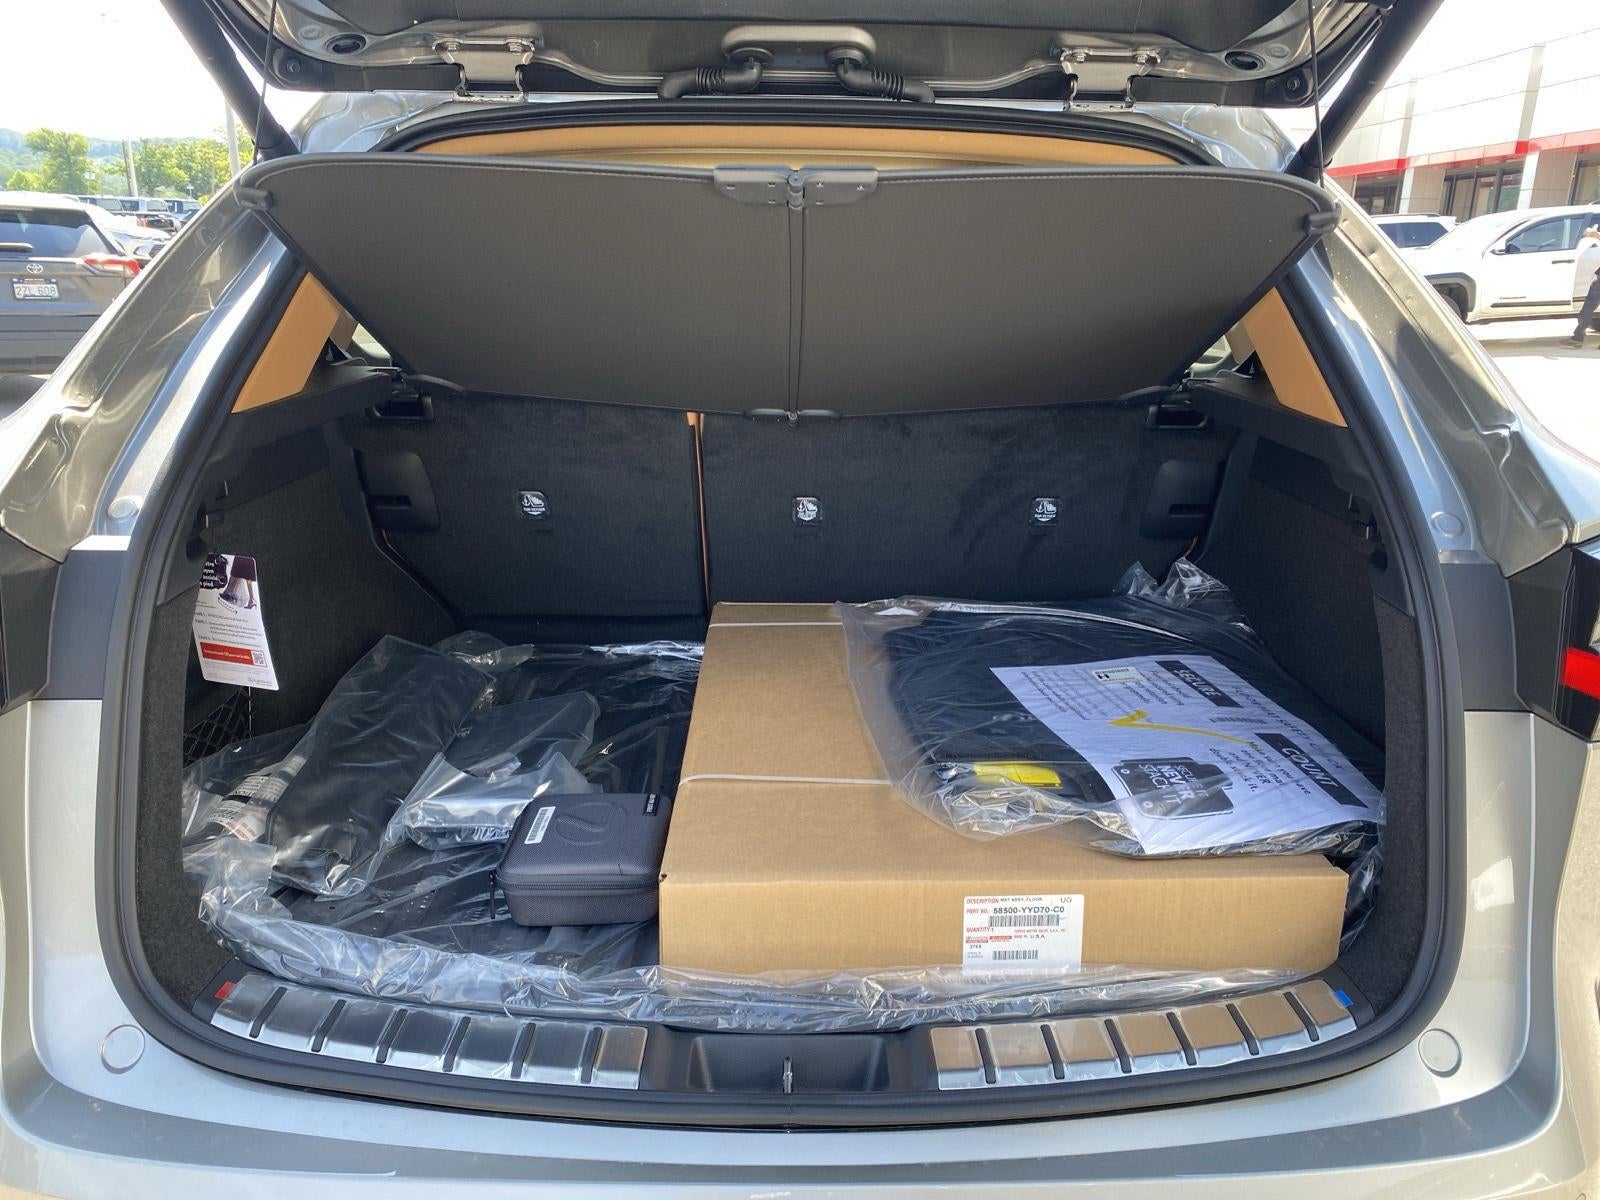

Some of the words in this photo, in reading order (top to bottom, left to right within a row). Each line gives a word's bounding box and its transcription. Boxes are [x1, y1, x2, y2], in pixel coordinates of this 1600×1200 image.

[1173, 669, 1222, 698] SECURE
[1243, 761, 1272, 785] NVER
[1277, 768, 1294, 779] you
[1282, 747, 1339, 787] COUNT
[1157, 765, 1195, 799] NEVER
[1162, 794, 1182, 804] IT
[993, 906, 1065, 914] 58500-YYD70-C0
